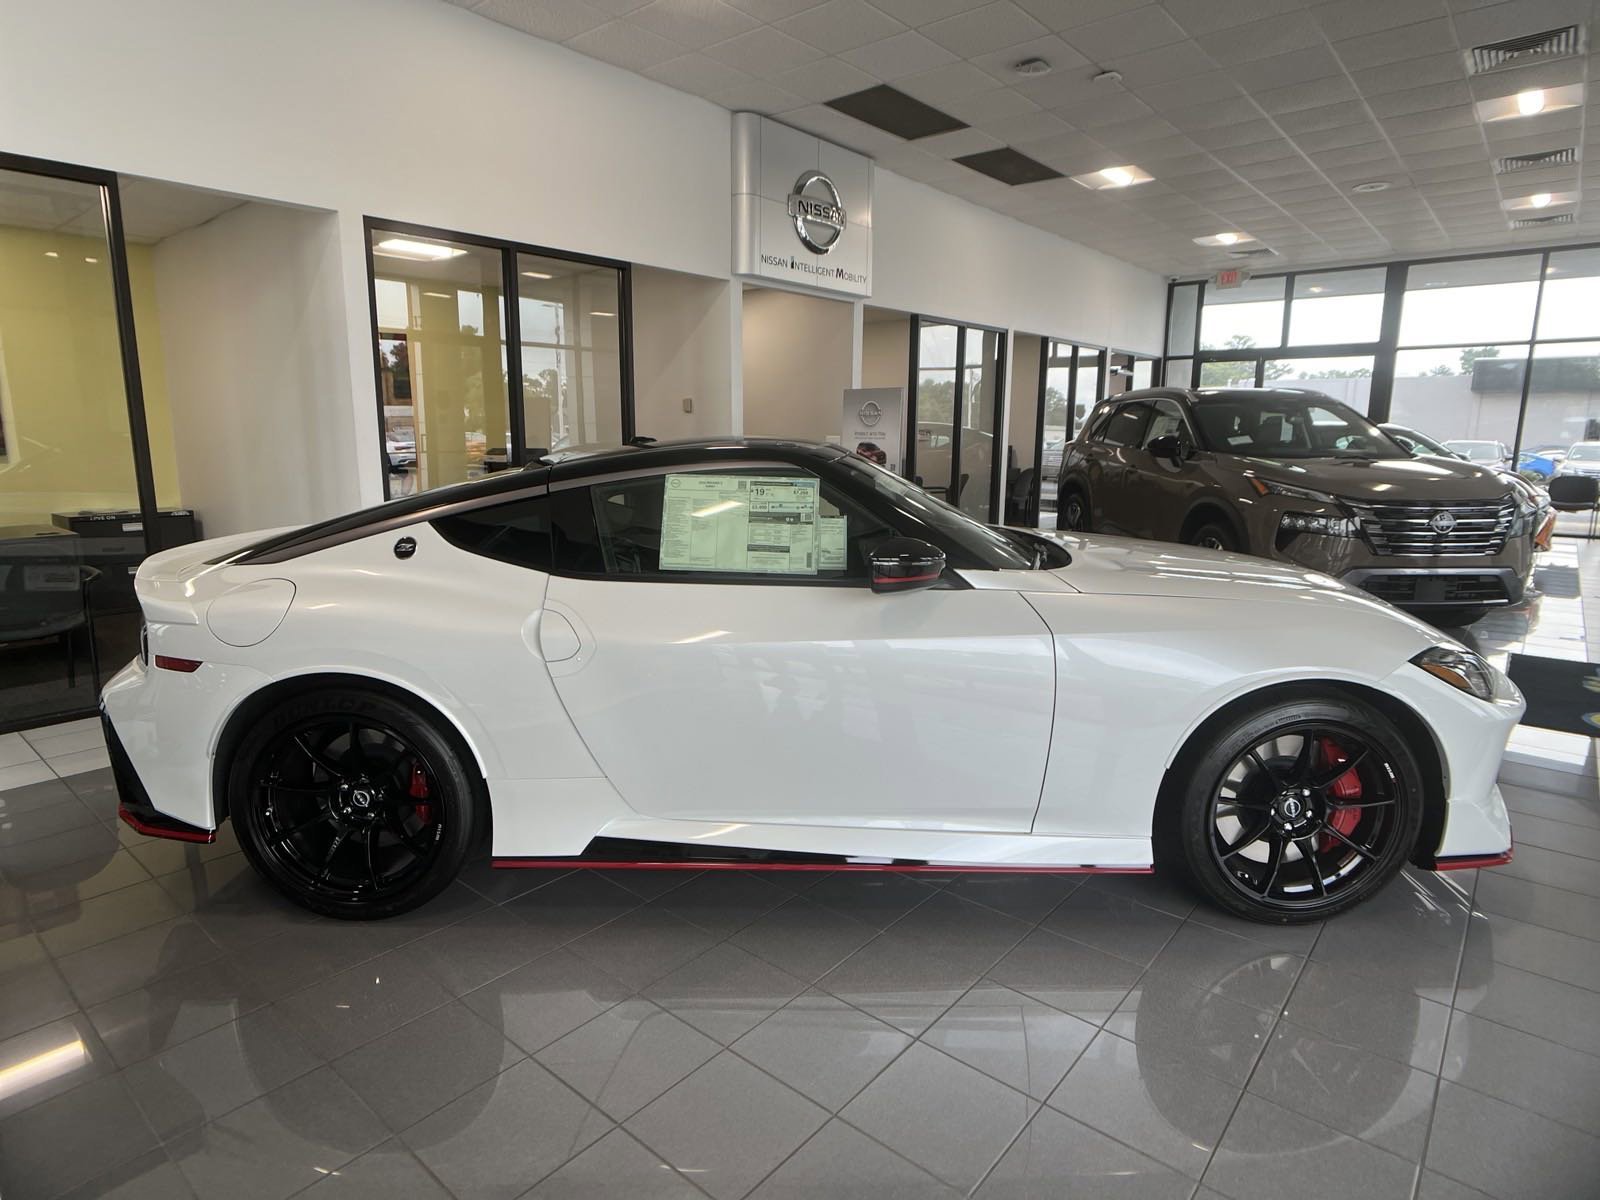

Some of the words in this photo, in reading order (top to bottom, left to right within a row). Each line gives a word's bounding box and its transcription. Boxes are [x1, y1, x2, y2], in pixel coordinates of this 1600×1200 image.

[798, 200, 845, 225] NISSAN
[761, 254, 788, 269] NISSAN
[835, 267, 867, 284] MOBILITY
[1220, 271, 1236, 283] EXIT
[755, 488, 765, 496] 19
